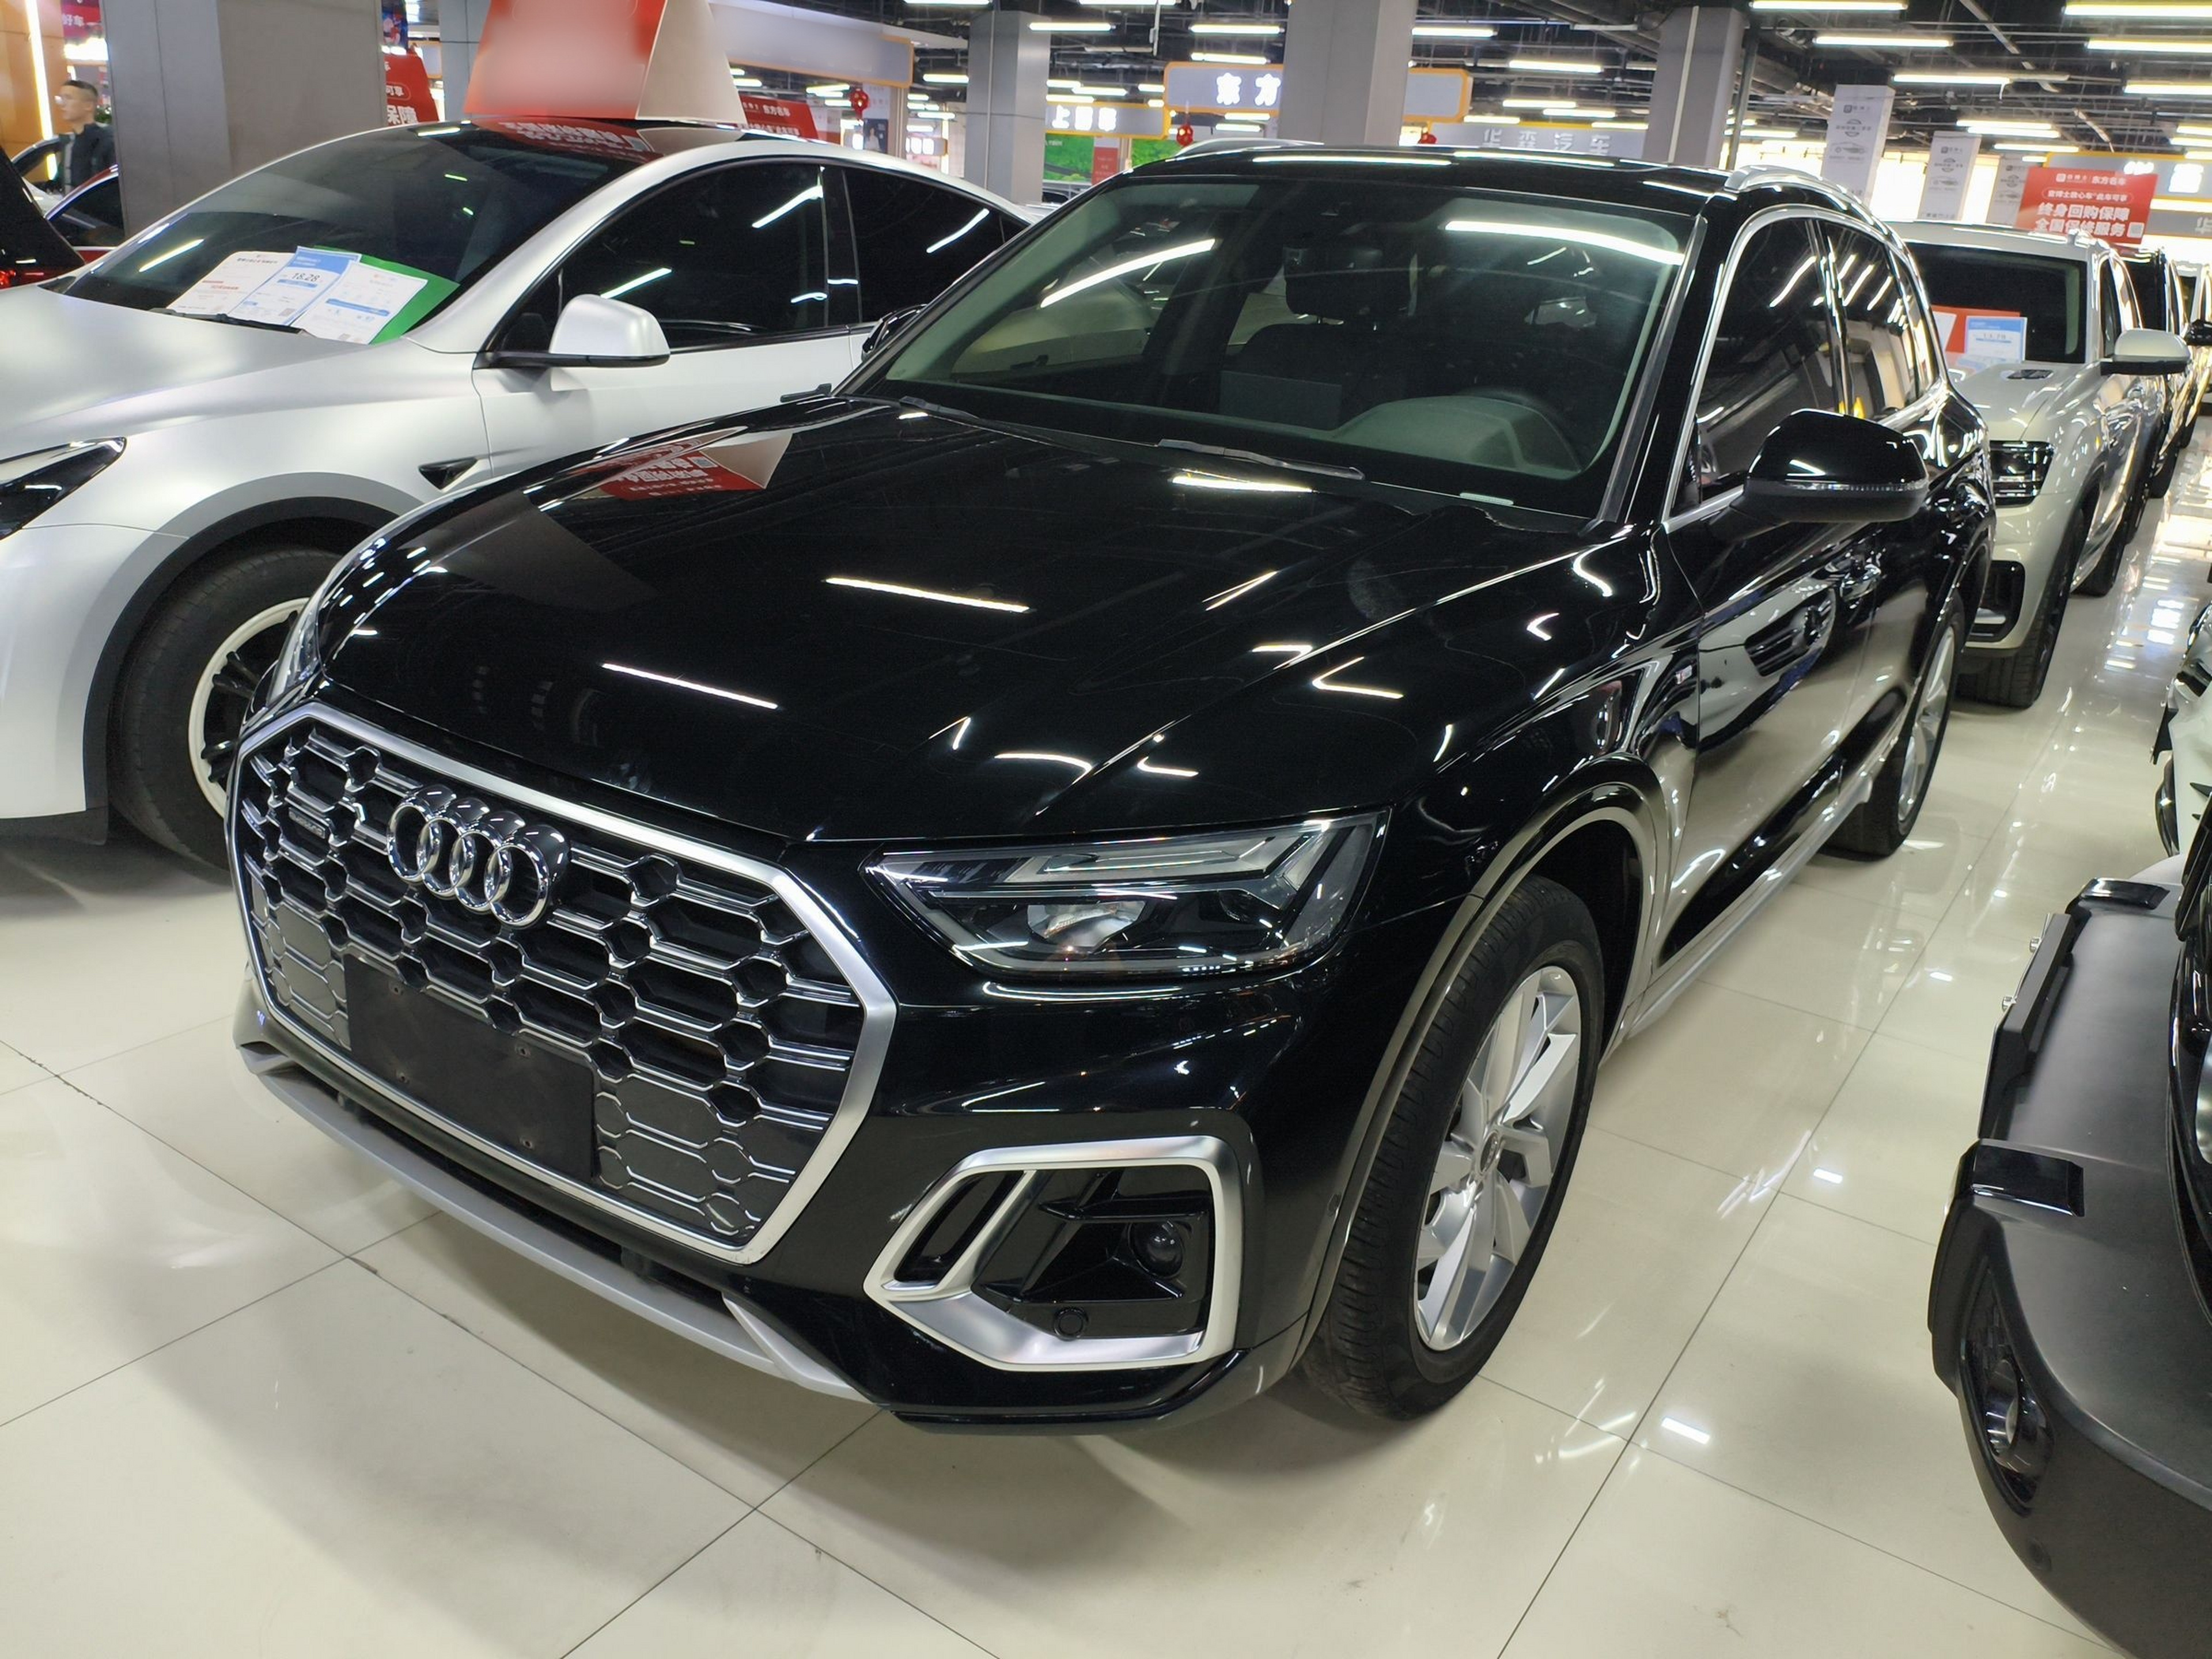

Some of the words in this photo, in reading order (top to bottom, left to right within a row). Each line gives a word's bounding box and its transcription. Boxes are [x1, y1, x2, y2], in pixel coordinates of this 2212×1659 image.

[2037, 202, 2131, 221] 终身回购保障
[291, 272, 321, 282] 18.28
